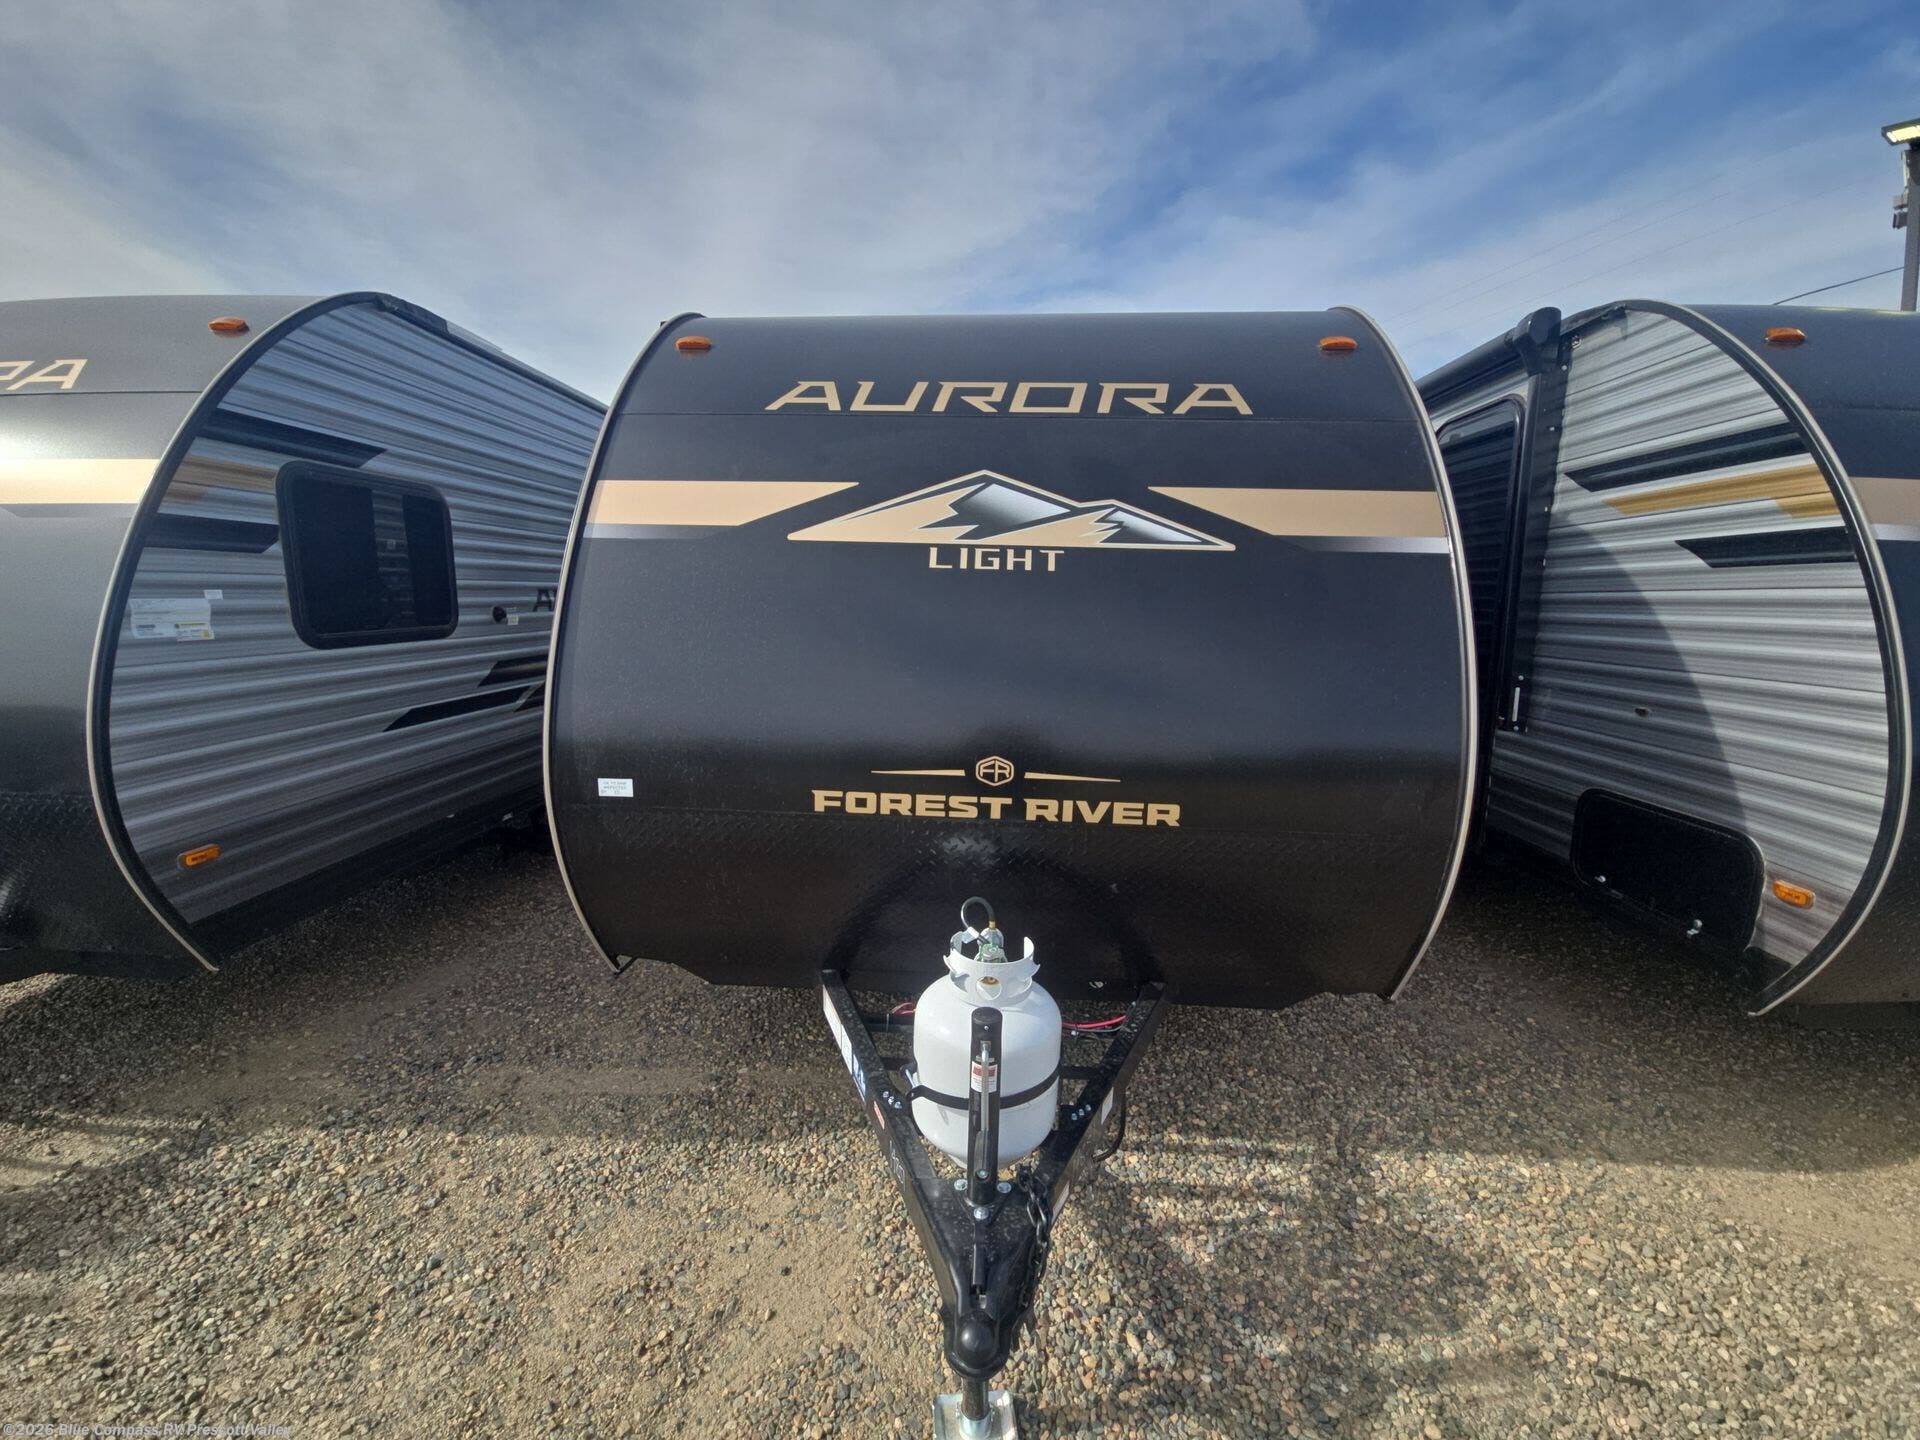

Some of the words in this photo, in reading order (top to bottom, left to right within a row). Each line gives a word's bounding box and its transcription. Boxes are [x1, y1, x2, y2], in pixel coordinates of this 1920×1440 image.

[765, 381, 1254, 415] AURORA
[928, 547, 1065, 571] LIGHT
[979, 759, 1011, 783] FR
[812, 789, 1013, 819] FOREST
[1023, 798, 1181, 827] RIVER
